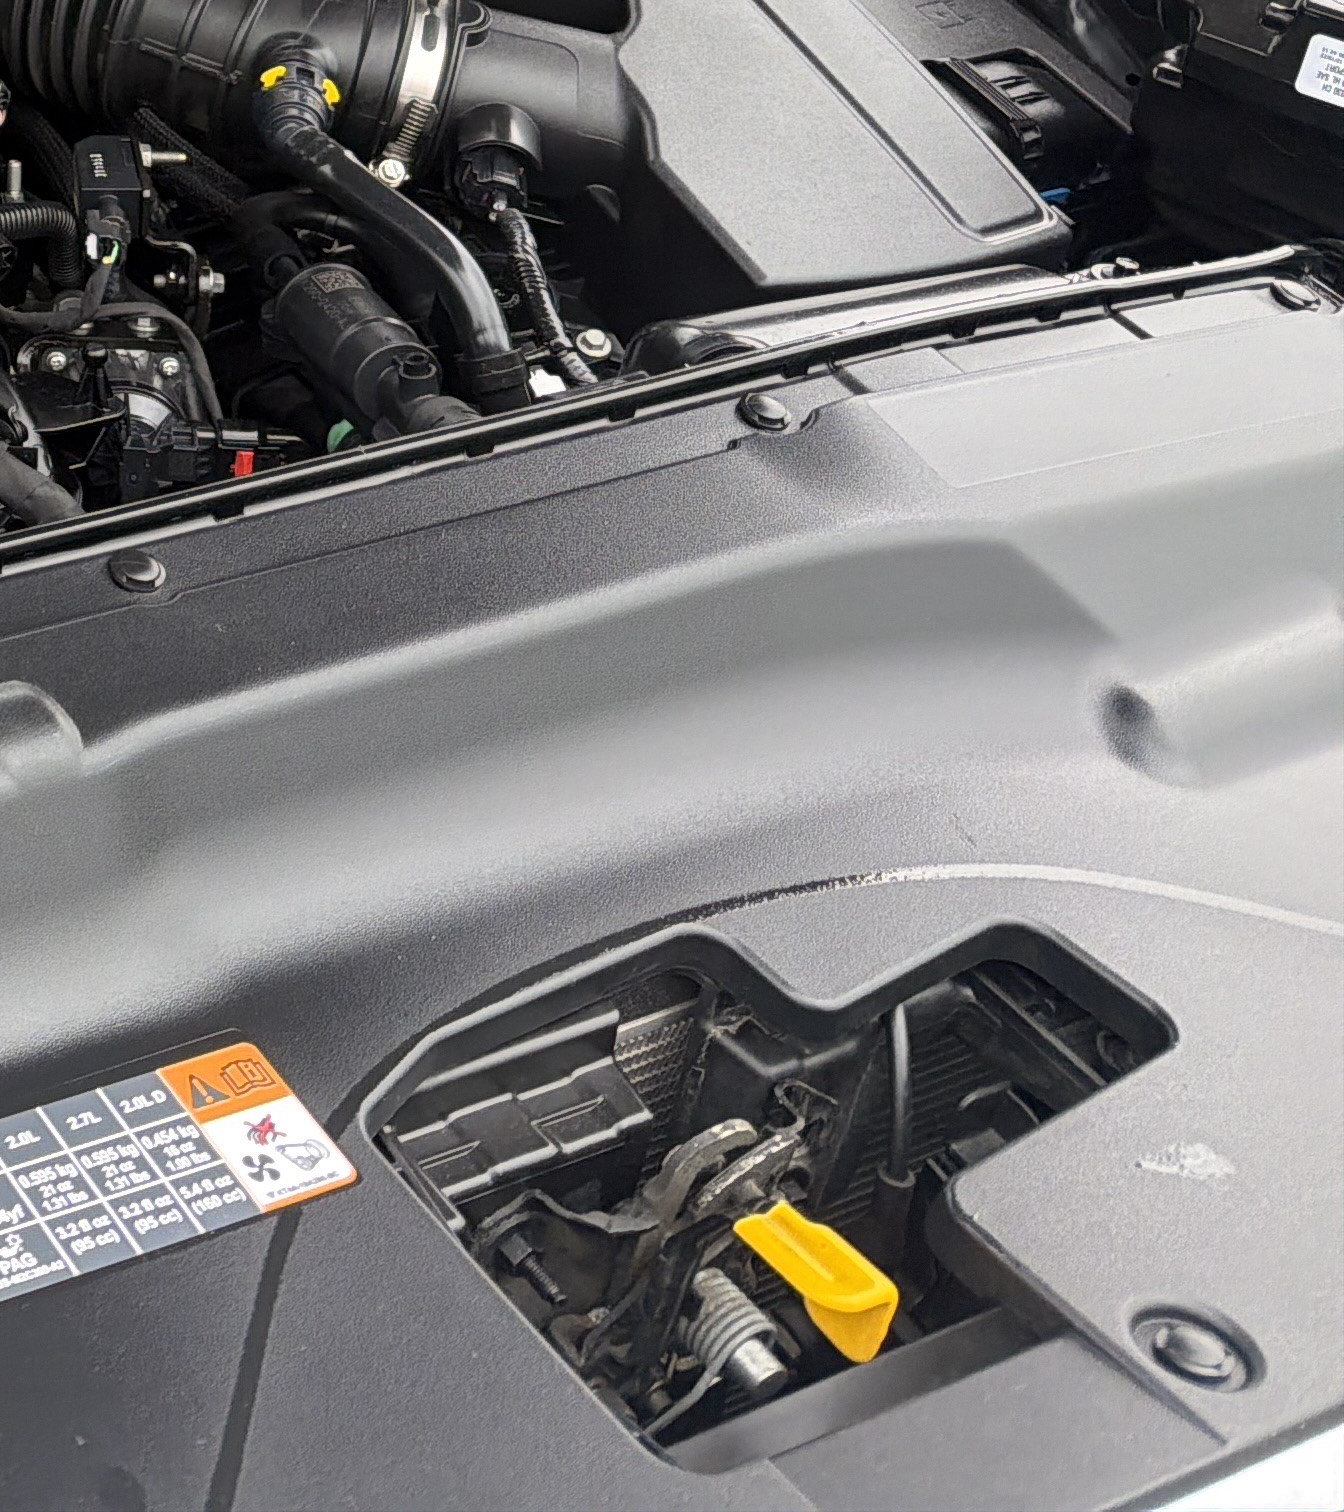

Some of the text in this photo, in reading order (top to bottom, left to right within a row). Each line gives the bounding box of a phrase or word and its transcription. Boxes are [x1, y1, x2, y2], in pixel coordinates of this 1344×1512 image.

[118, 1089, 167, 1114] 2.0L D
[65, 1111, 103, 1131] 2.7L
[3, 1130, 42, 1151] 2.0L
[179, 1123, 201, 1141] kg
[120, 1141, 141, 1161] kg
[179, 1141, 197, 1154] oz
[120, 1160, 137, 1174] oz
[190, 1150, 212, 1166] lbs
[57, 1162, 79, 1180] kg
[130, 1170, 152, 1187] lbs
[58, 1180, 75, 1193] oz
[179, 1182, 203, 1200] 5.4
[217, 1174, 235, 1189] oz
[68, 1190, 89, 1206] lbs
[221, 1187, 247, 1206] cc)
[118, 1201, 141, 1220] 3.2
[156, 1194, 175, 1209] oz
[55, 1221, 78, 1240] 3.2
[93, 1213, 112, 1229] oz
[134, 1208, 184, 1235] (95 cc)
[70, 1229, 121, 1256] (95 cc)
